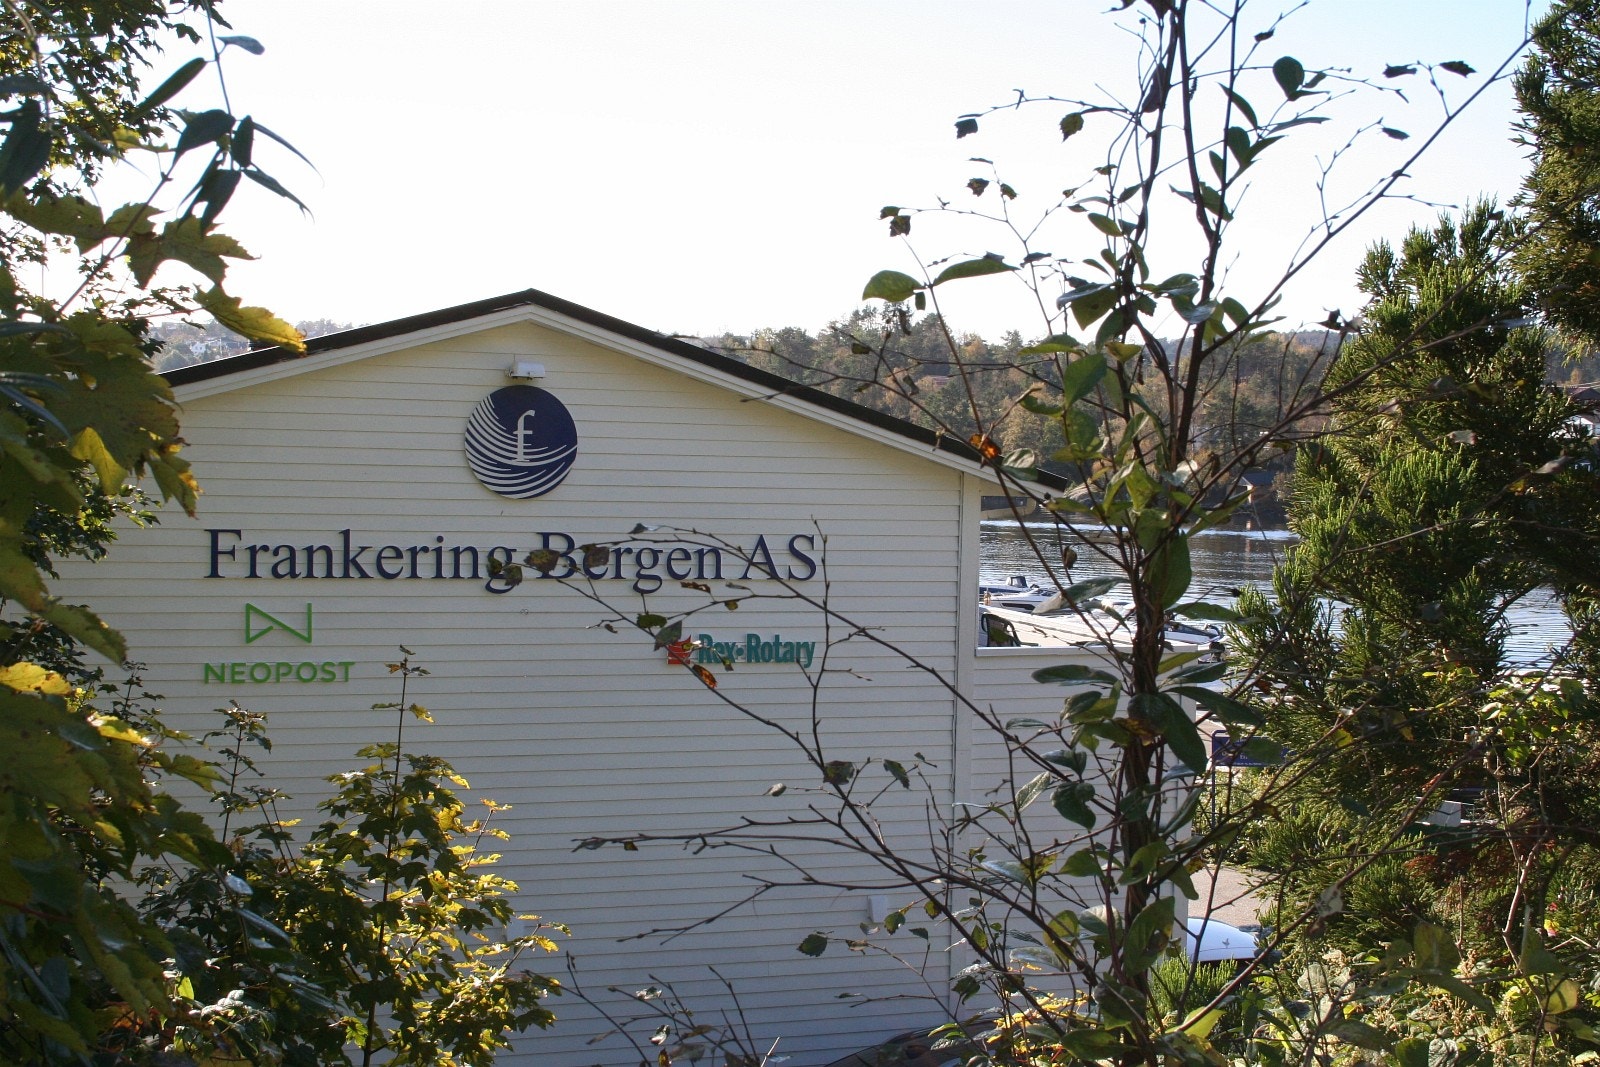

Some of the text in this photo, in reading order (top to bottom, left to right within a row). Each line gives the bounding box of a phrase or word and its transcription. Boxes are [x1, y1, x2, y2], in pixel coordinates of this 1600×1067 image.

[203, 528, 517, 594] Frankering
[740, 534, 818, 581] AS
[204, 661, 355, 684] NEOPOST
